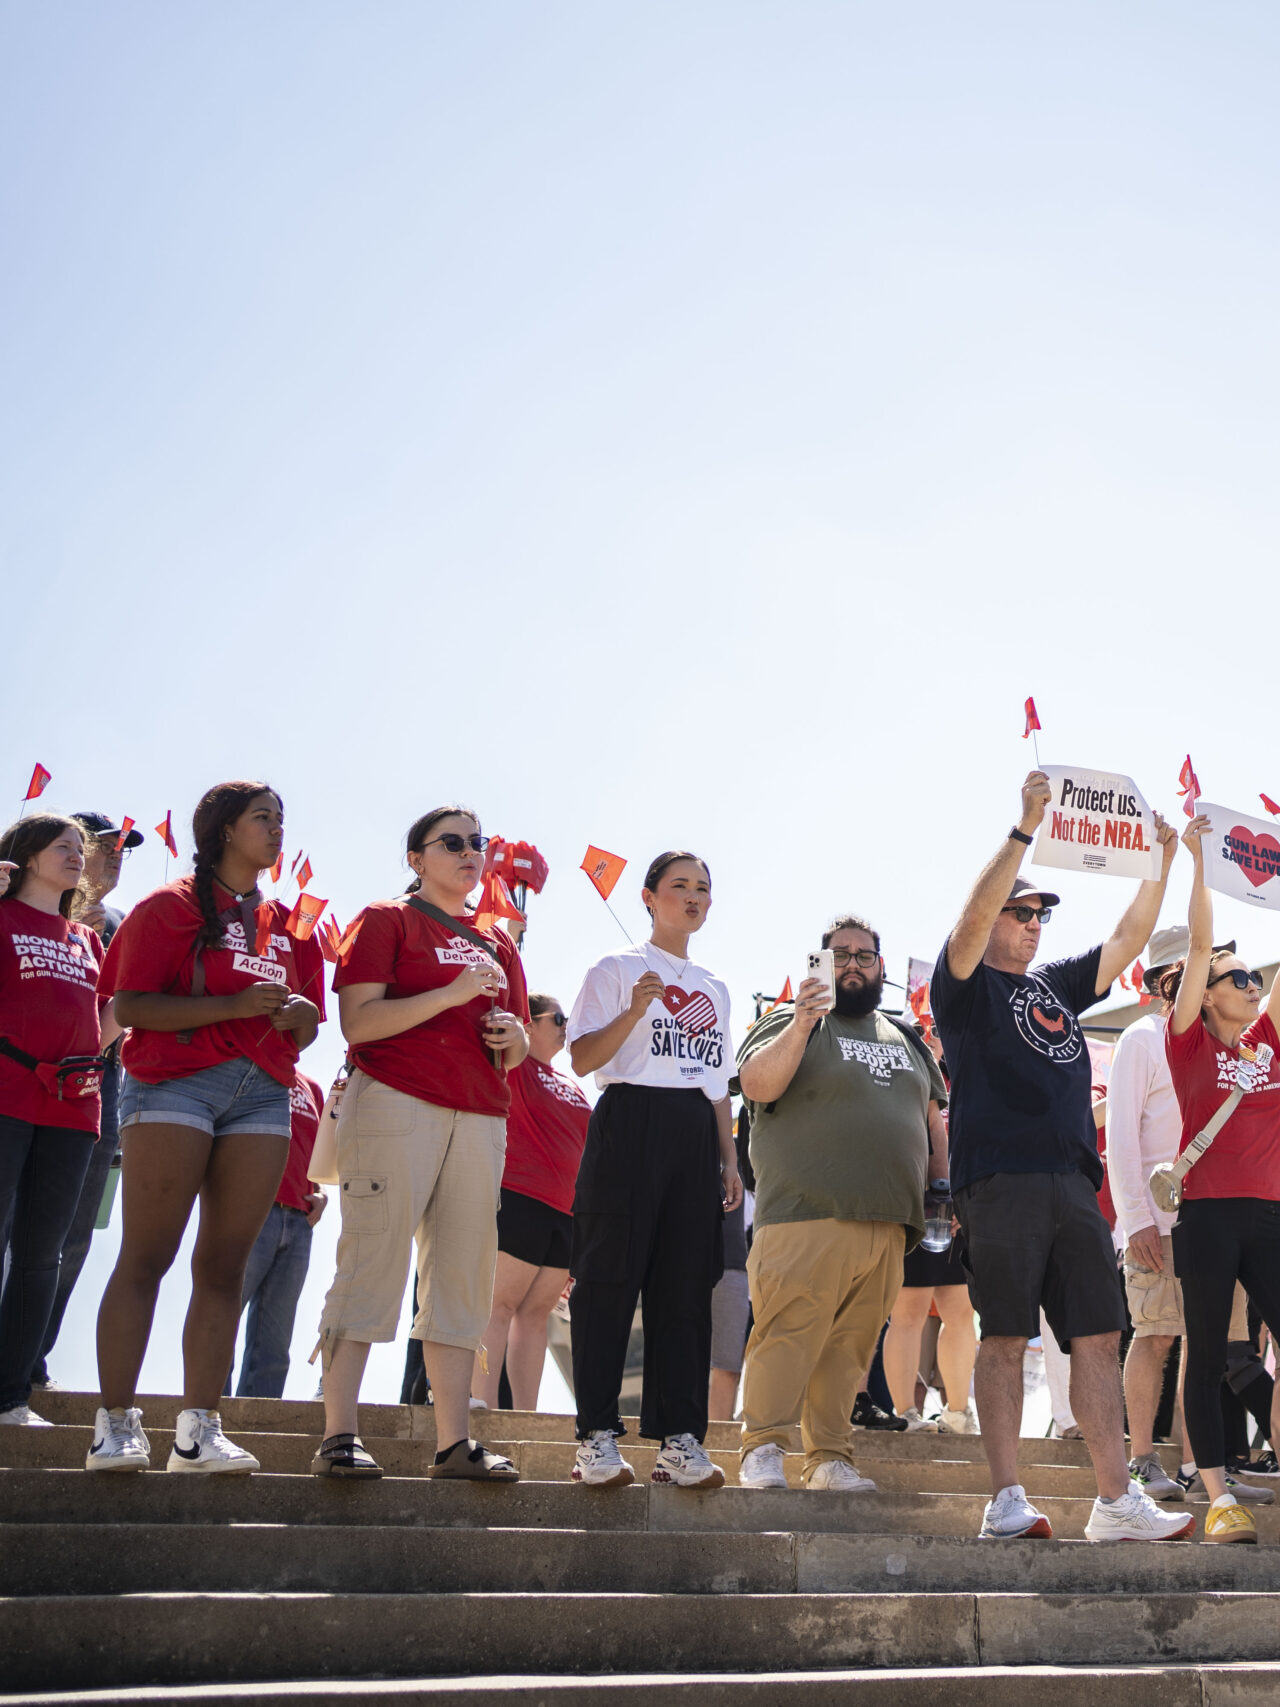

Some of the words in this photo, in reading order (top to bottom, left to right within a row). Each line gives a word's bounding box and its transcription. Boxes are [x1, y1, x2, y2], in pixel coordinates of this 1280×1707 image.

[1060, 778, 1114, 814] Protect
[1118, 794, 1142, 818] us.
[1051, 811, 1075, 842] Not
[1078, 815, 1100, 846] the
[1104, 819, 1150, 852] NRA.
[1224, 834, 1250, 854] GUN
[1222, 847, 1252, 868] SAVE
[11, 934, 69, 952] MOMS
[20, 956, 87, 979] ACTION
[21, 970, 35, 980] FOR
[36, 969, 51, 978] GUN
[239, 958, 283, 979] Action
[651, 1018, 684, 1031] GUN
[651, 1031, 687, 1058] SAVE
[687, 1036, 724, 1068] LIVES
[839, 1041, 908, 1059] WORKING
[841, 1049, 914, 1071] PEOPLE
[869, 1066, 892, 1078] PAC
